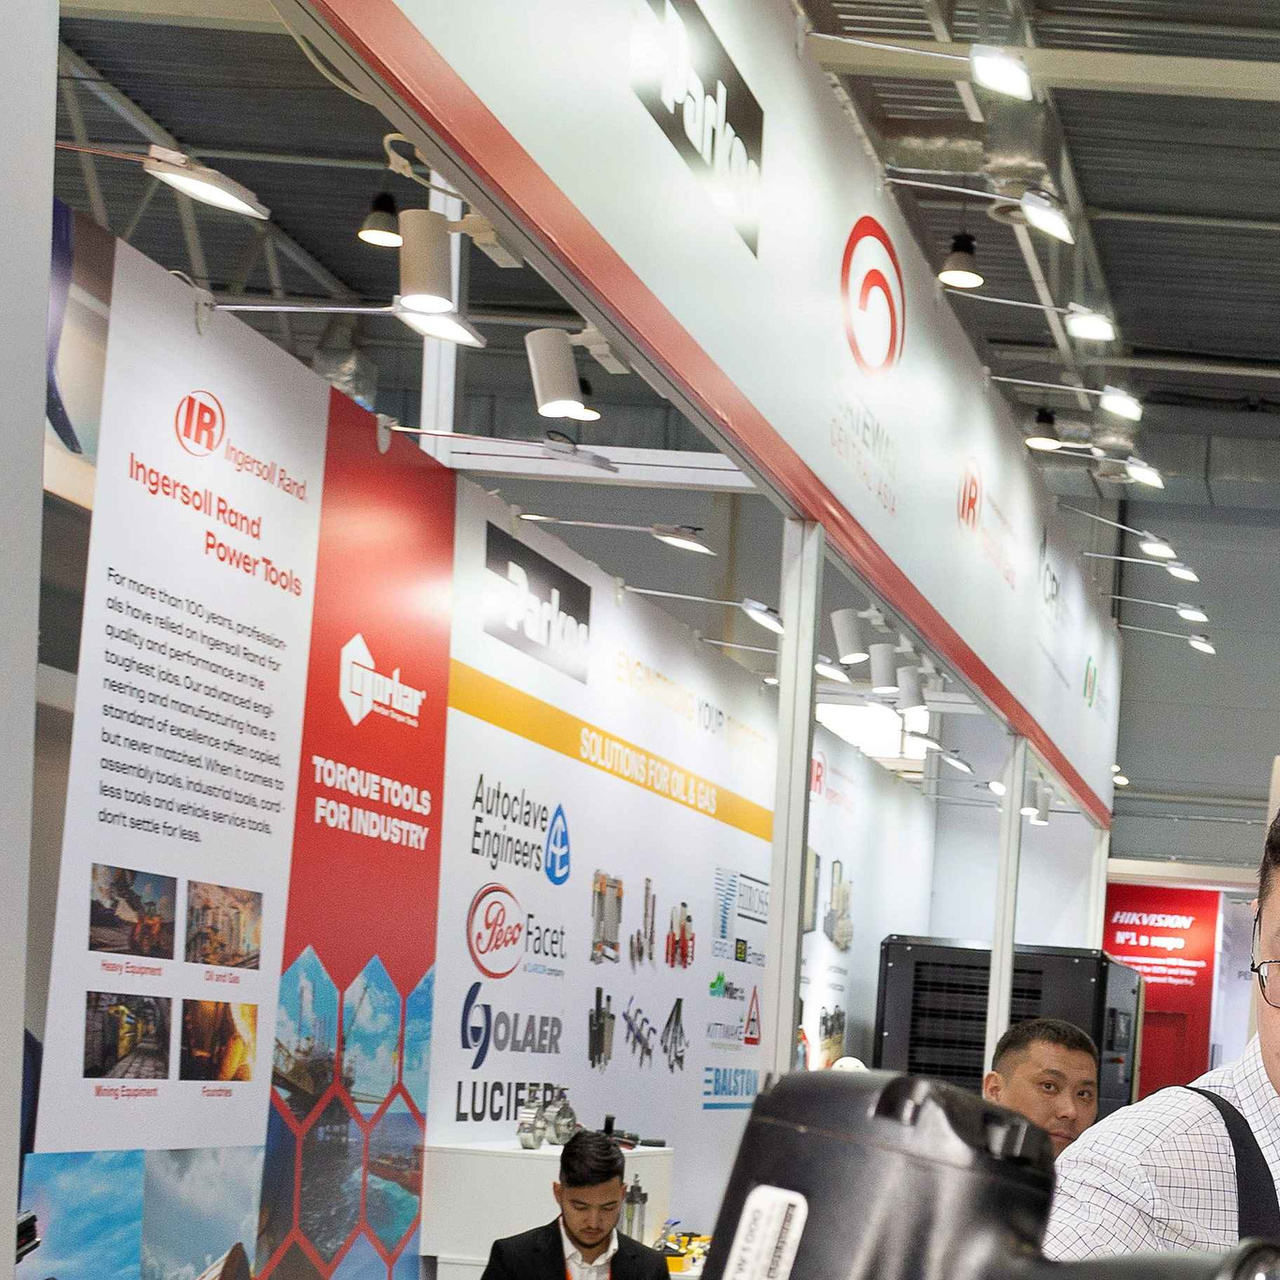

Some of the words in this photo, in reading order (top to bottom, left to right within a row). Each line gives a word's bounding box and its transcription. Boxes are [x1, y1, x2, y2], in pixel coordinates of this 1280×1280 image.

[183, 395, 217, 451] IR
[129, 452, 212, 516] Ingersoll
[216, 496, 262, 540] Rand
[224, 438, 277, 485] Ingersoll
[278, 469, 307, 501] Rand
[961, 469, 978, 532] IR
[205, 530, 259, 576] Power
[262, 557, 302, 596] Tools
[107, 567, 125, 586] For
[129, 579, 156, 599] more
[159, 589, 183, 610] than
[187, 599, 204, 618] 100
[106, 596, 124, 613] als
[126, 601, 152, 624] have
[154, 615, 183, 636] relied
[185, 627, 199, 642] on
[201, 630, 240, 657] Ingersoll
[105, 624, 145, 650] quality
[146, 638, 167, 656] and
[169, 646, 235, 679] performance
[236, 670, 249, 684] on
[105, 650, 156, 678] toughest
[184, 676, 201, 693] Our
[203, 684, 251, 710] advanced
[103, 677, 145, 703] neering
[148, 690, 169, 708] and
[103, 704, 154, 730] standard
[157, 718, 169, 732] of
[101, 756, 154, 784] assembly
[102, 727, 121, 748] but
[123, 736, 153, 755] never
[205, 755, 234, 776] When
[580, 727, 647, 784] SOLUTIONS
[648, 758, 669, 794] FOR
[670, 770, 687, 801] OIL
[697, 783, 717, 815] GAS
[100, 780, 122, 800] less
[124, 788, 151, 807] tools
[154, 796, 175, 812] and
[312, 755, 380, 801] TORQUE
[381, 777, 432, 816] TOOLS
[472, 774, 548, 832] Autoclave
[162, 820, 177, 837] for
[314, 796, 350, 831] FOR
[352, 807, 429, 851] INDUSTRY
[471, 816, 543, 870] Engineers
[476, 901, 523, 955] Peco
[525, 913, 568, 960] Facet
[1112, 911, 1196, 930] HIKVISION
[493, 1011, 562, 1054] OLAER
[456, 1080, 554, 1122] LUCIF
